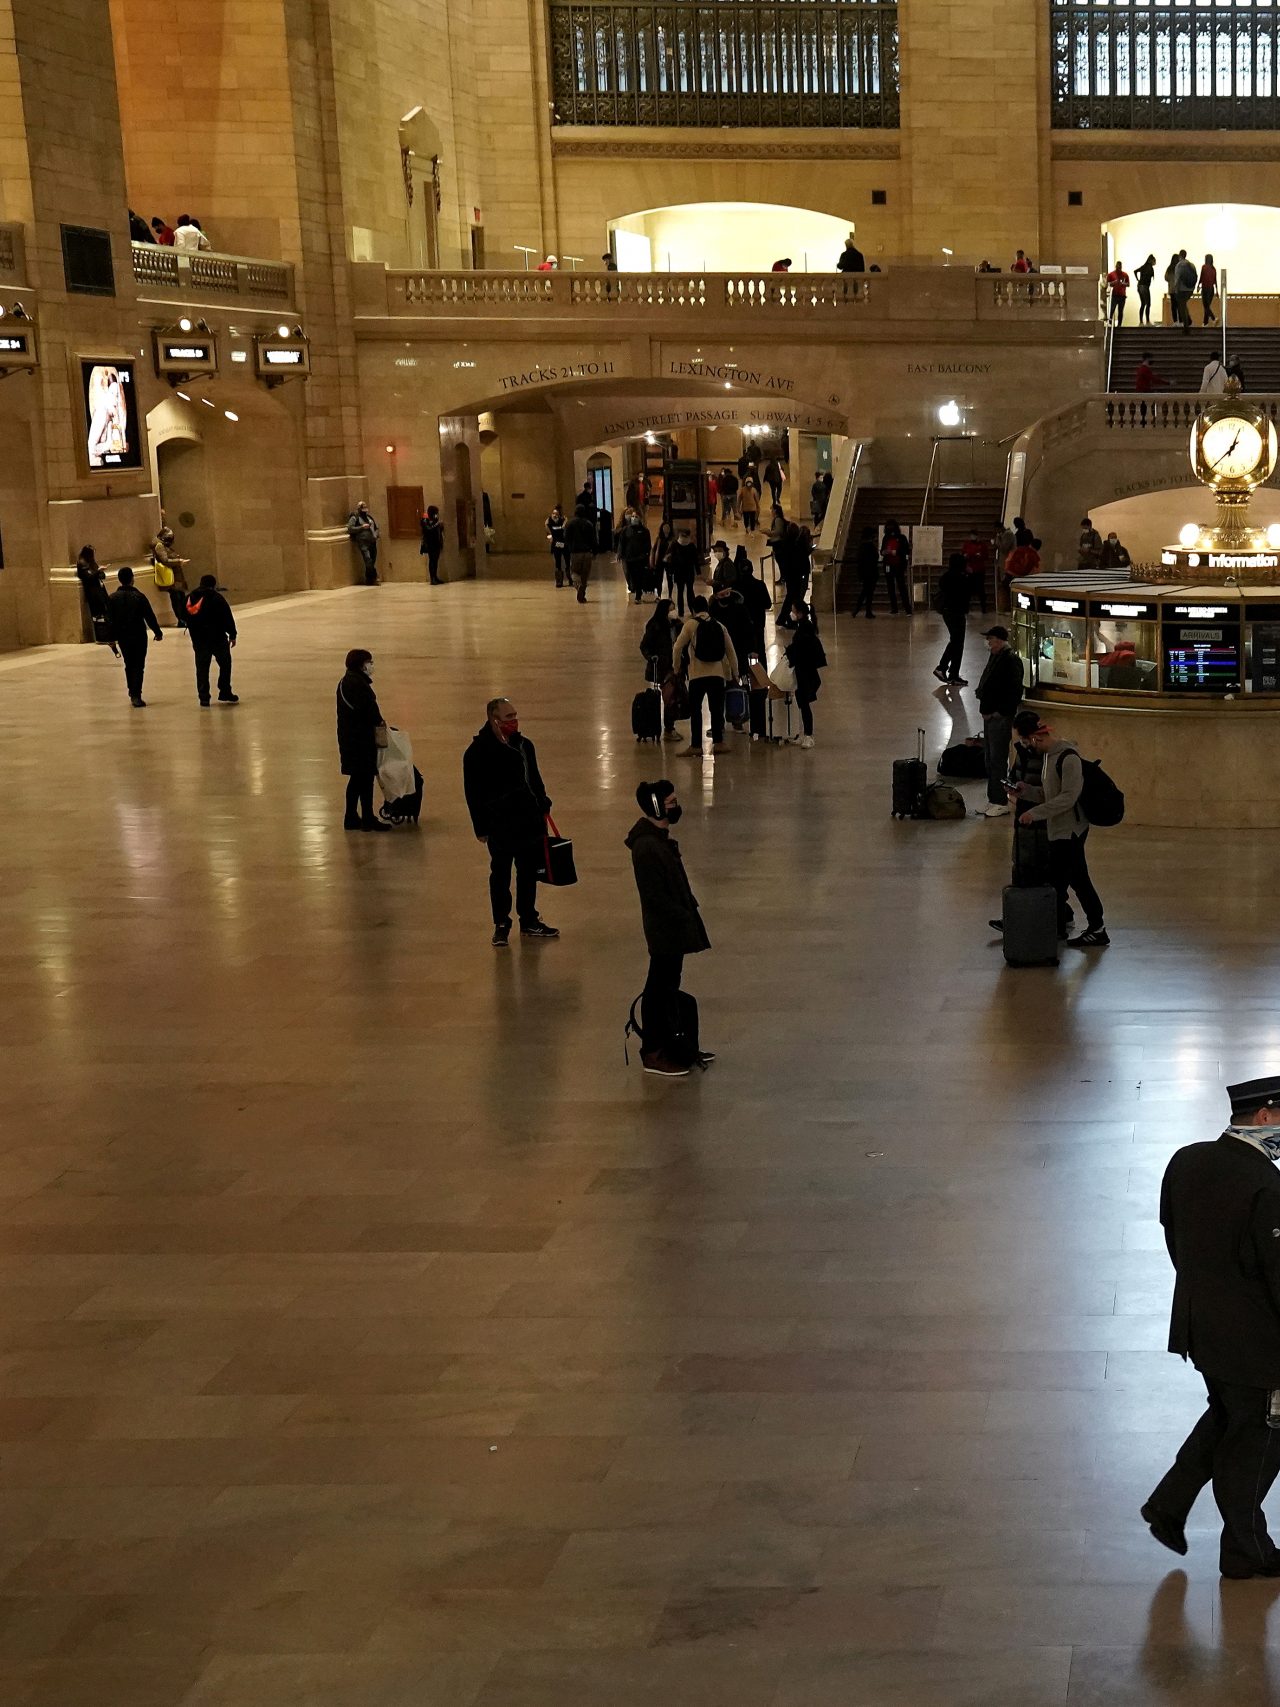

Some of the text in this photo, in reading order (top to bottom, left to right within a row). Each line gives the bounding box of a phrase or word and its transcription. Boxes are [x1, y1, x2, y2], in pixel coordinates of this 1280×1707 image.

[498, 362, 615, 390] TRACKS 21 TO 11
[670, 361, 795, 392] LEXINGTON AVE
[907, 363, 991, 374] EAST BALCONY
[603, 419, 635, 434] 42ND
[637, 412, 682, 428] STREET
[685, 410, 738, 422] PASSAGE
[749, 410, 801, 424] SUBWAY
[1208, 553, 1278, 568] Information
[1182, 631, 1220, 640] ARRIVALS
